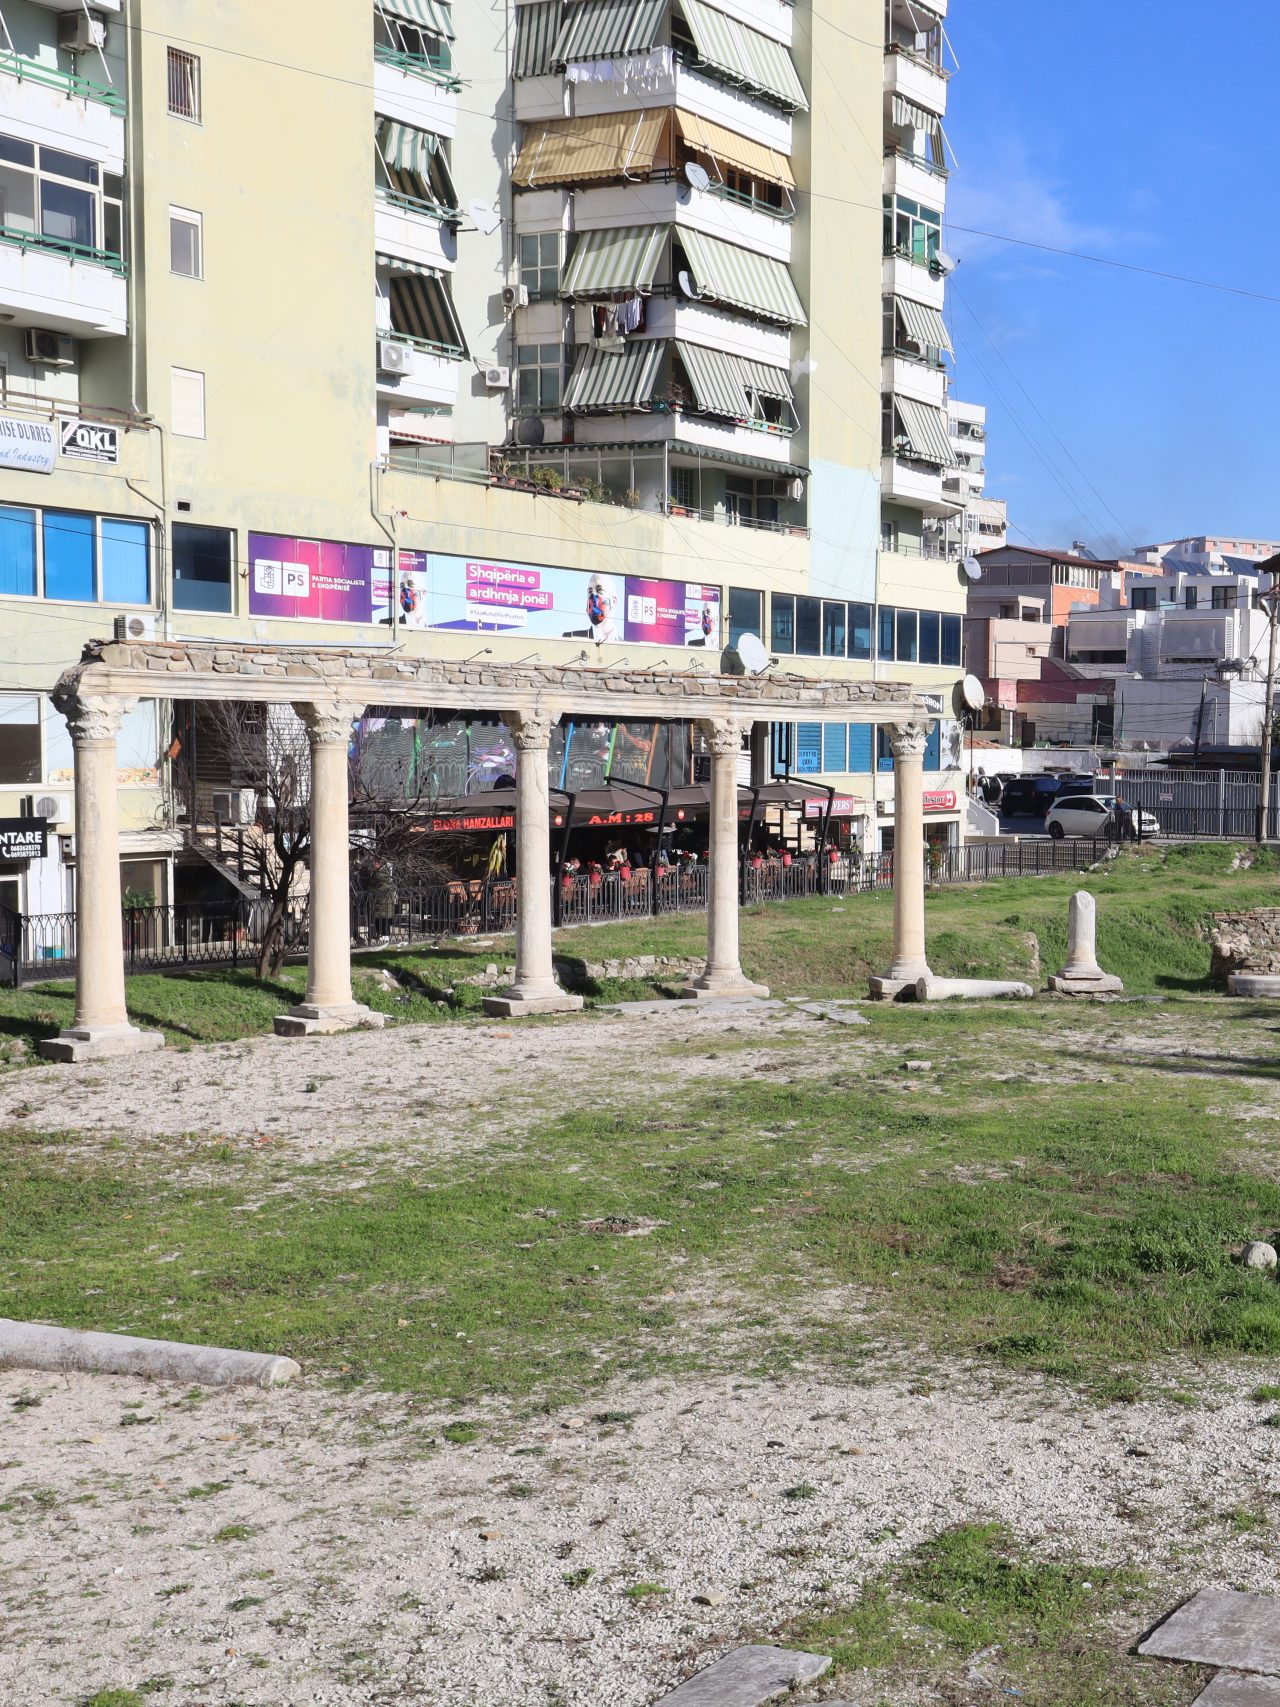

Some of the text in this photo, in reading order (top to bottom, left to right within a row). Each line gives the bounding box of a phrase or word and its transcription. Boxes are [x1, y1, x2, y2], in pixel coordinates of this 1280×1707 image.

[16, 422, 52, 444] DURRES
[76, 427, 116, 451] QKL
[13, 448, 50, 467] Industry
[287, 573, 304, 586] PS
[312, 575, 365, 586] PARTIA SOCIALISTE
[469, 565, 536, 584] Shqipëria e
[470, 587, 549, 605] ardhmja jonë!
[644, 606, 654, 616] PS
[463, 816, 514, 830] HAMZALLARI
[588, 814, 623, 825] A.M
[634, 812, 653, 822] 28
